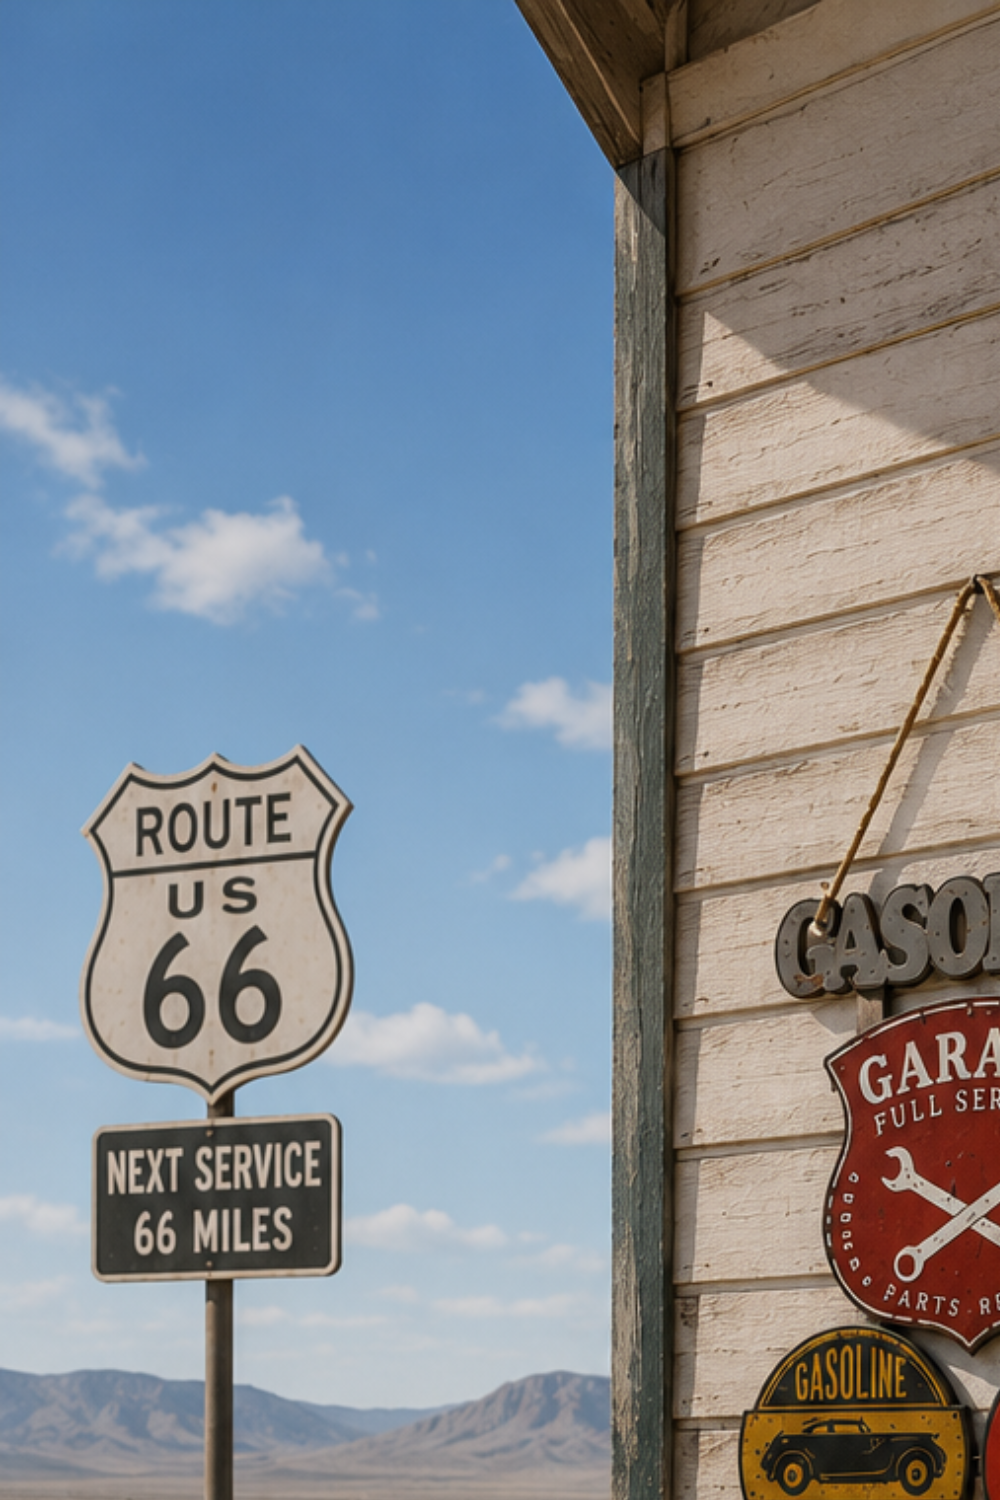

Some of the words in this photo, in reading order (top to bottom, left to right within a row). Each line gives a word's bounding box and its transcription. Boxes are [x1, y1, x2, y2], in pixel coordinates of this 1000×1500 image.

[135, 792, 292, 857] ROUTE
[143, 925, 283, 1049] 66
[873, 1095, 943, 1137] FULL
[107, 1147, 183, 1195] NEXT
[194, 1140, 322, 1193] SERVICE
[134, 1210, 177, 1257] 66
[193, 1206, 293, 1254] MILES
[883, 1283, 960, 1318] PARTS
[794, 1344, 908, 1403] GASOLINE
